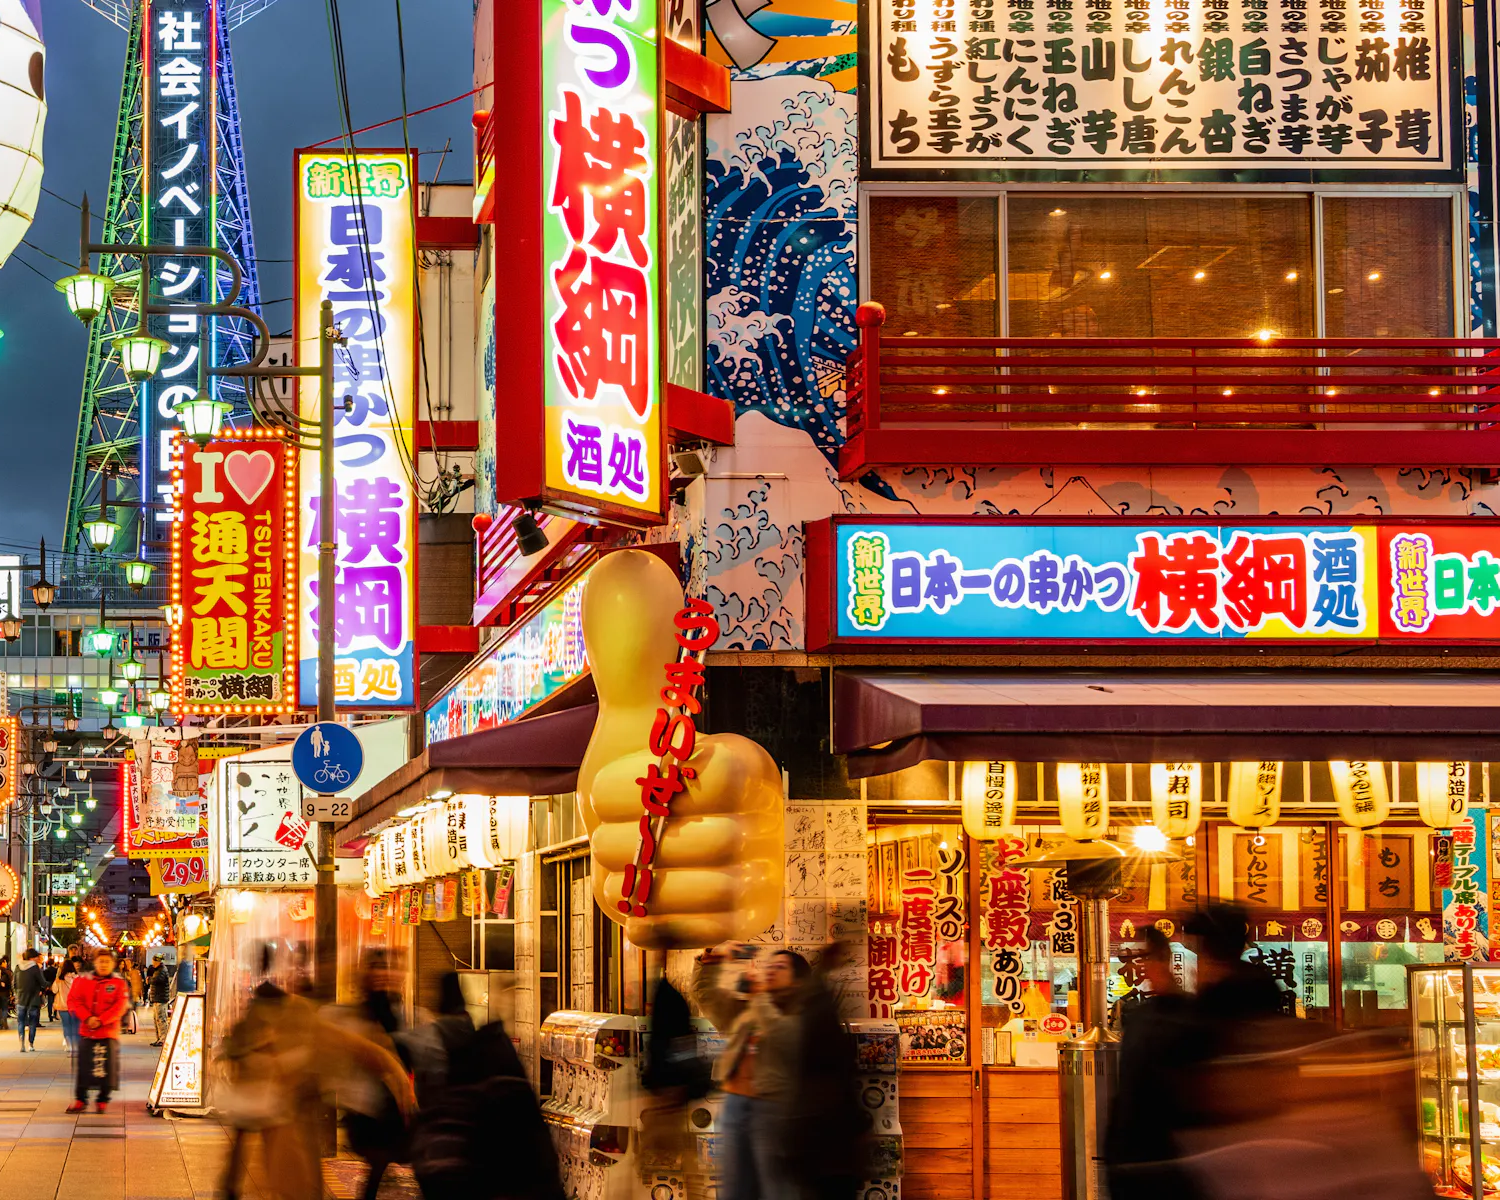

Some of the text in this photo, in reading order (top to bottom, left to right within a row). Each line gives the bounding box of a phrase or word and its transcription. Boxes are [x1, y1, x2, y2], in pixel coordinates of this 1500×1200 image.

[887, 37, 920, 154] もち
[964, 38, 1002, 153] 紅しょうが
[1003, 38, 1039, 154] にんにく
[1082, 38, 1118, 154] 山芋
[1120, 38, 1157, 154] しし唐
[1160, 37, 1196, 154] れんこん
[1197, 37, 1236, 154] 銀杏
[1238, 37, 1276, 154] 白ねぎ
[1276, 37, 1313, 154] さつま芋
[1316, 37, 1353, 154] じゃが芋
[1355, 37, 1393, 154] 茄子
[1393, 37, 1432, 154] 椎茸
[308, 163, 403, 198] 新世界
[553, 0, 651, 416] つ 横綱
[192, 452, 224, 504] I
[567, 418, 644, 495] 酒処
[192, 511, 249, 669] 通天閣
[253, 509, 273, 667] TSUTENKAKU
[853, 536, 885, 626] 新世界
[891, 536, 1307, 629] 日本一の串かつ 横綱
[1313, 537, 1359, 628] 酒処
[1397, 538, 1428, 627] 新世界
[184, 677, 217, 687] 日本一の
[184, 688, 217, 699] 串かつ
[217, 674, 274, 700] 横綱
[1169, 775, 1190, 820] 寿司
[1448, 762, 1466, 814] お造り
[162, 857, 205, 885] 299
[227, 872, 310, 883] 2F 座敷あります
[228, 857, 310, 868] 1F カウンター席
[935, 849, 963, 939] ソースの
[1247, 839, 1268, 904] にんにく
[1378, 847, 1401, 898] もち
[901, 868, 936, 992] 二度漬け
